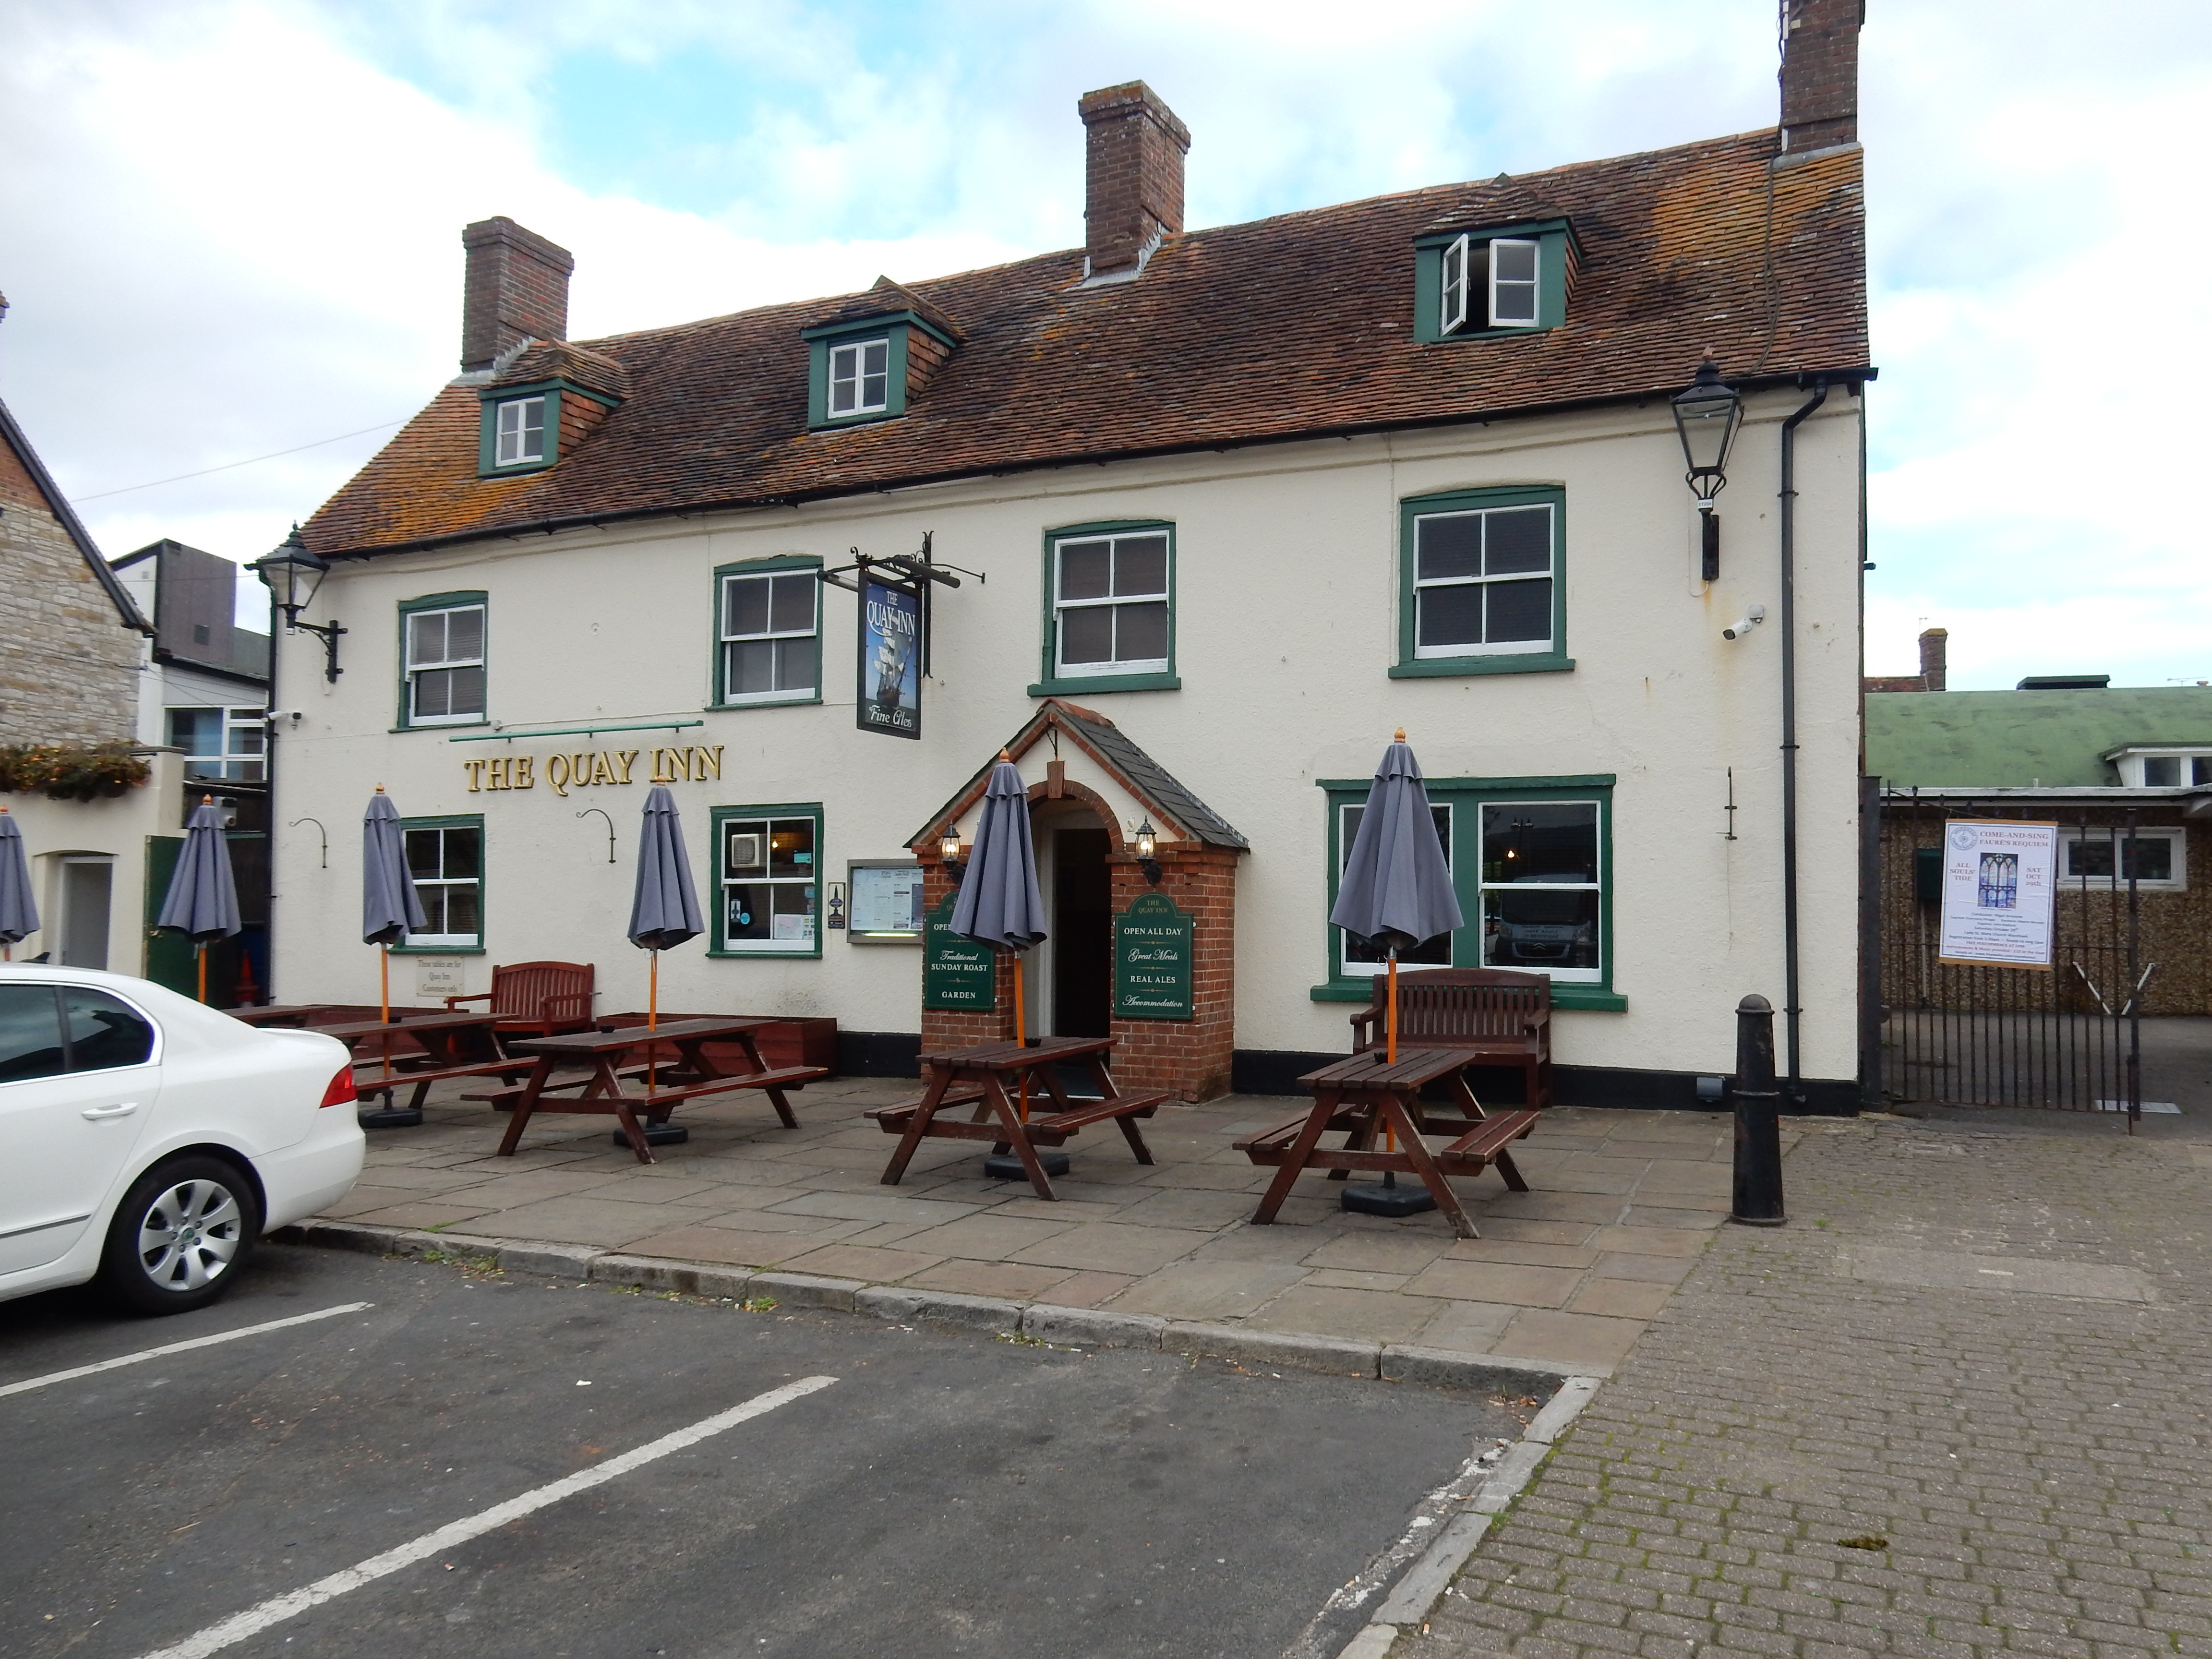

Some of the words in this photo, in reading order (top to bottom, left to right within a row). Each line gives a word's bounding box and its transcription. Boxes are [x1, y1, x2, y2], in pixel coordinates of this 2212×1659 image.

[887, 590, 898, 606] THE
[866, 600, 893, 637] QUAY
[898, 612, 915, 636] INN
[869, 705, 890, 723] Fine
[893, 709, 912, 728] Ales
[464, 756, 535, 792] THE
[545, 750, 639, 797] QUAY
[649, 745, 724, 783] INN
[1980, 831, 2048, 839] COME-AND-SING
[940, 950, 979, 961] Traditional
[1128, 948, 1152, 962] Great
[1153, 949, 1178, 961] Meals
[1122, 994, 1183, 1008] Accommodation
